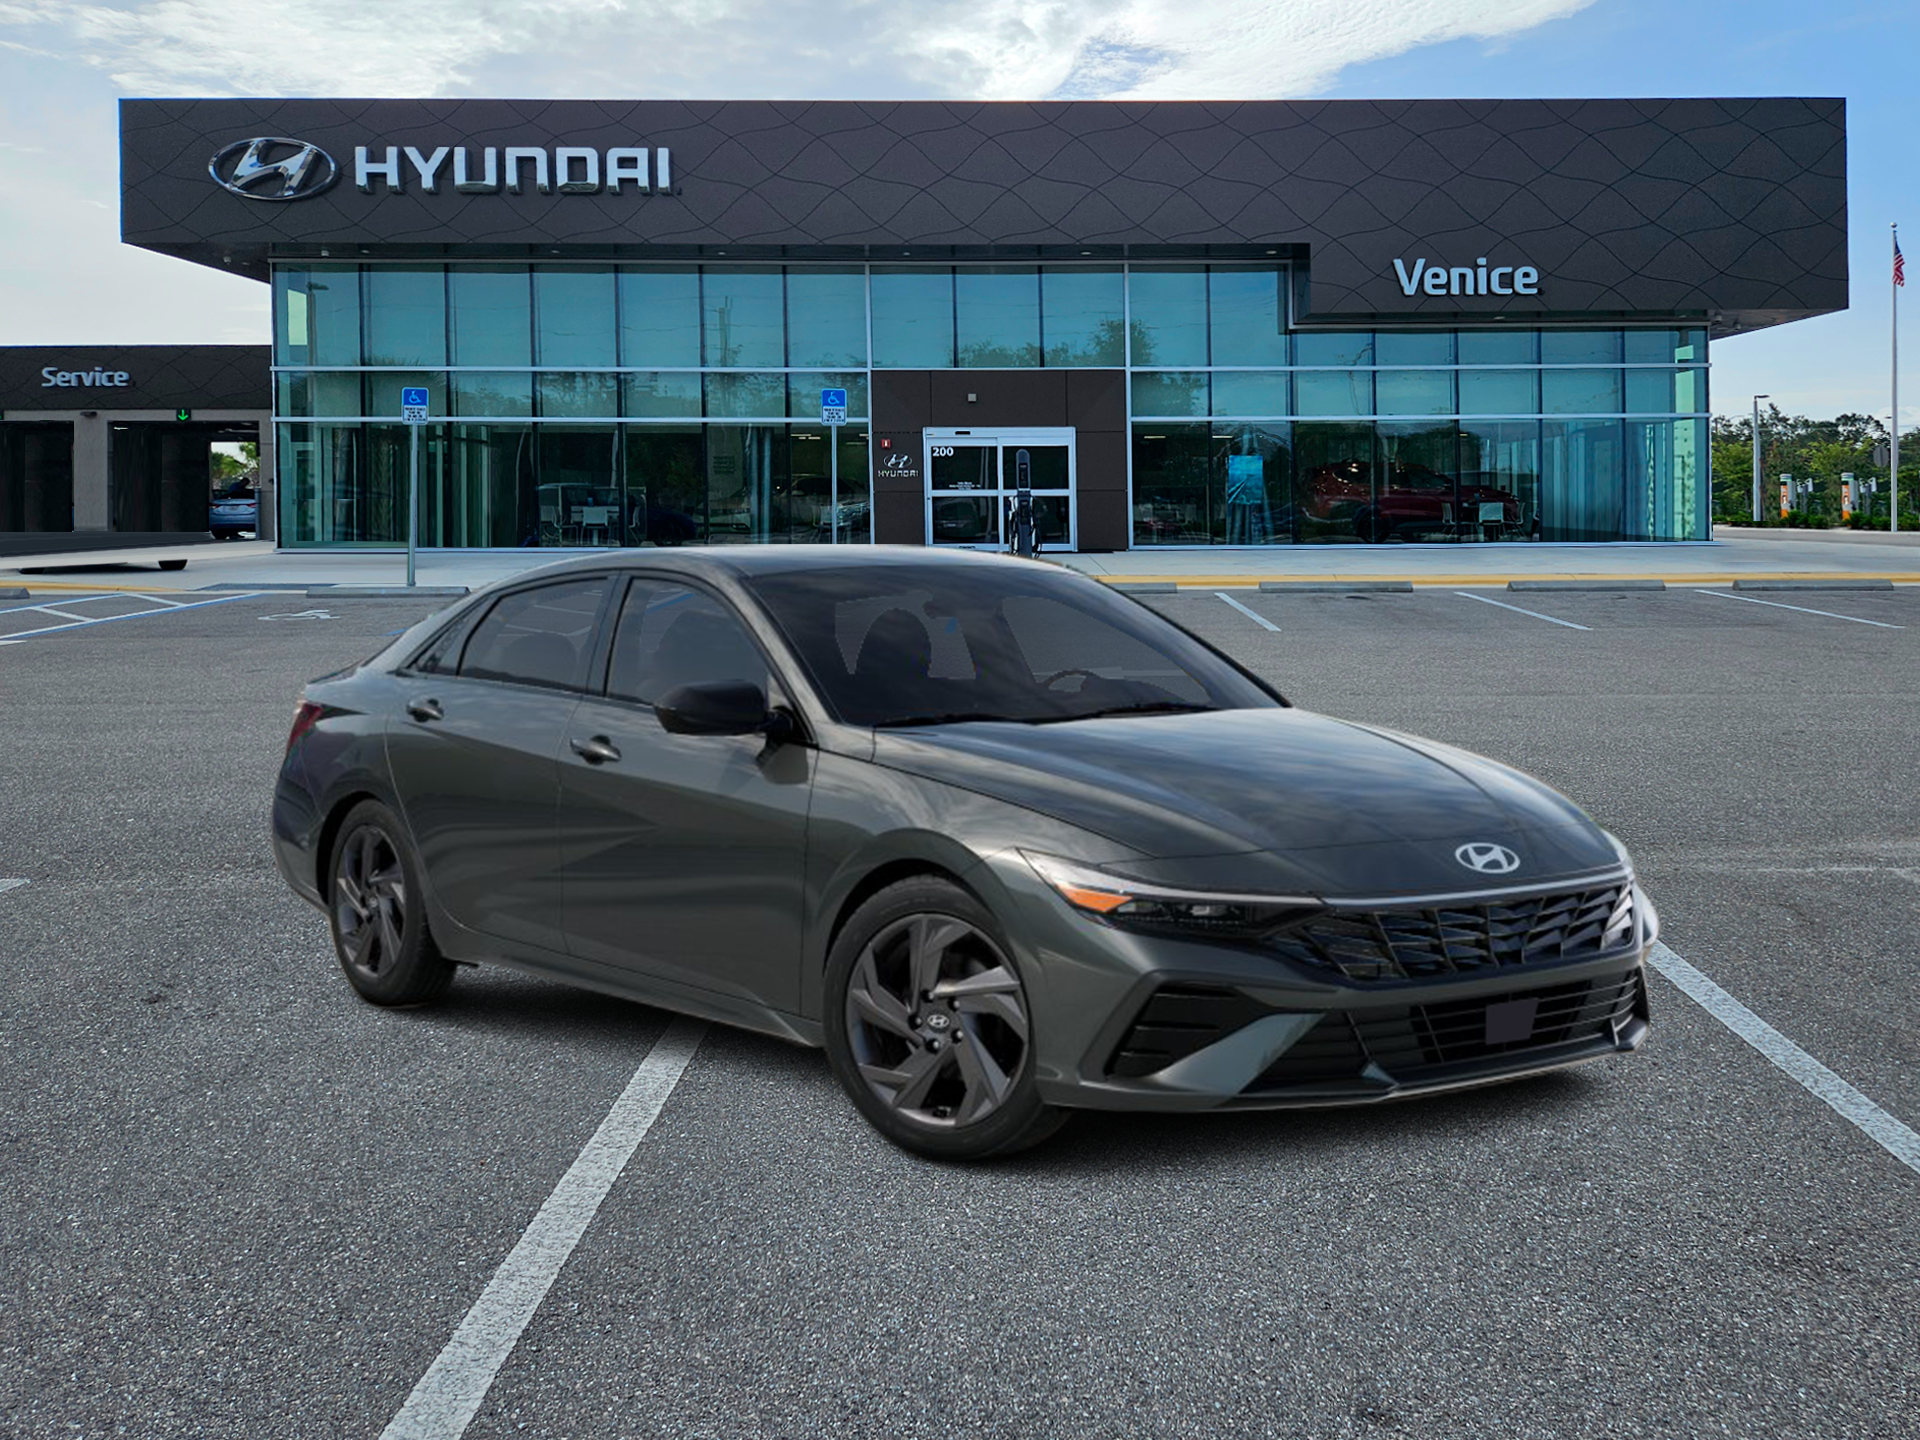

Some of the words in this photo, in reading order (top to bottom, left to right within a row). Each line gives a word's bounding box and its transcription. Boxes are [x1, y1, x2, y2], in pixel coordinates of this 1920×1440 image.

[354, 146, 671, 195] HYUNDAI
[1393, 257, 1539, 295] Venice
[41, 366, 130, 387] Service
[932, 446, 954, 457] 200
